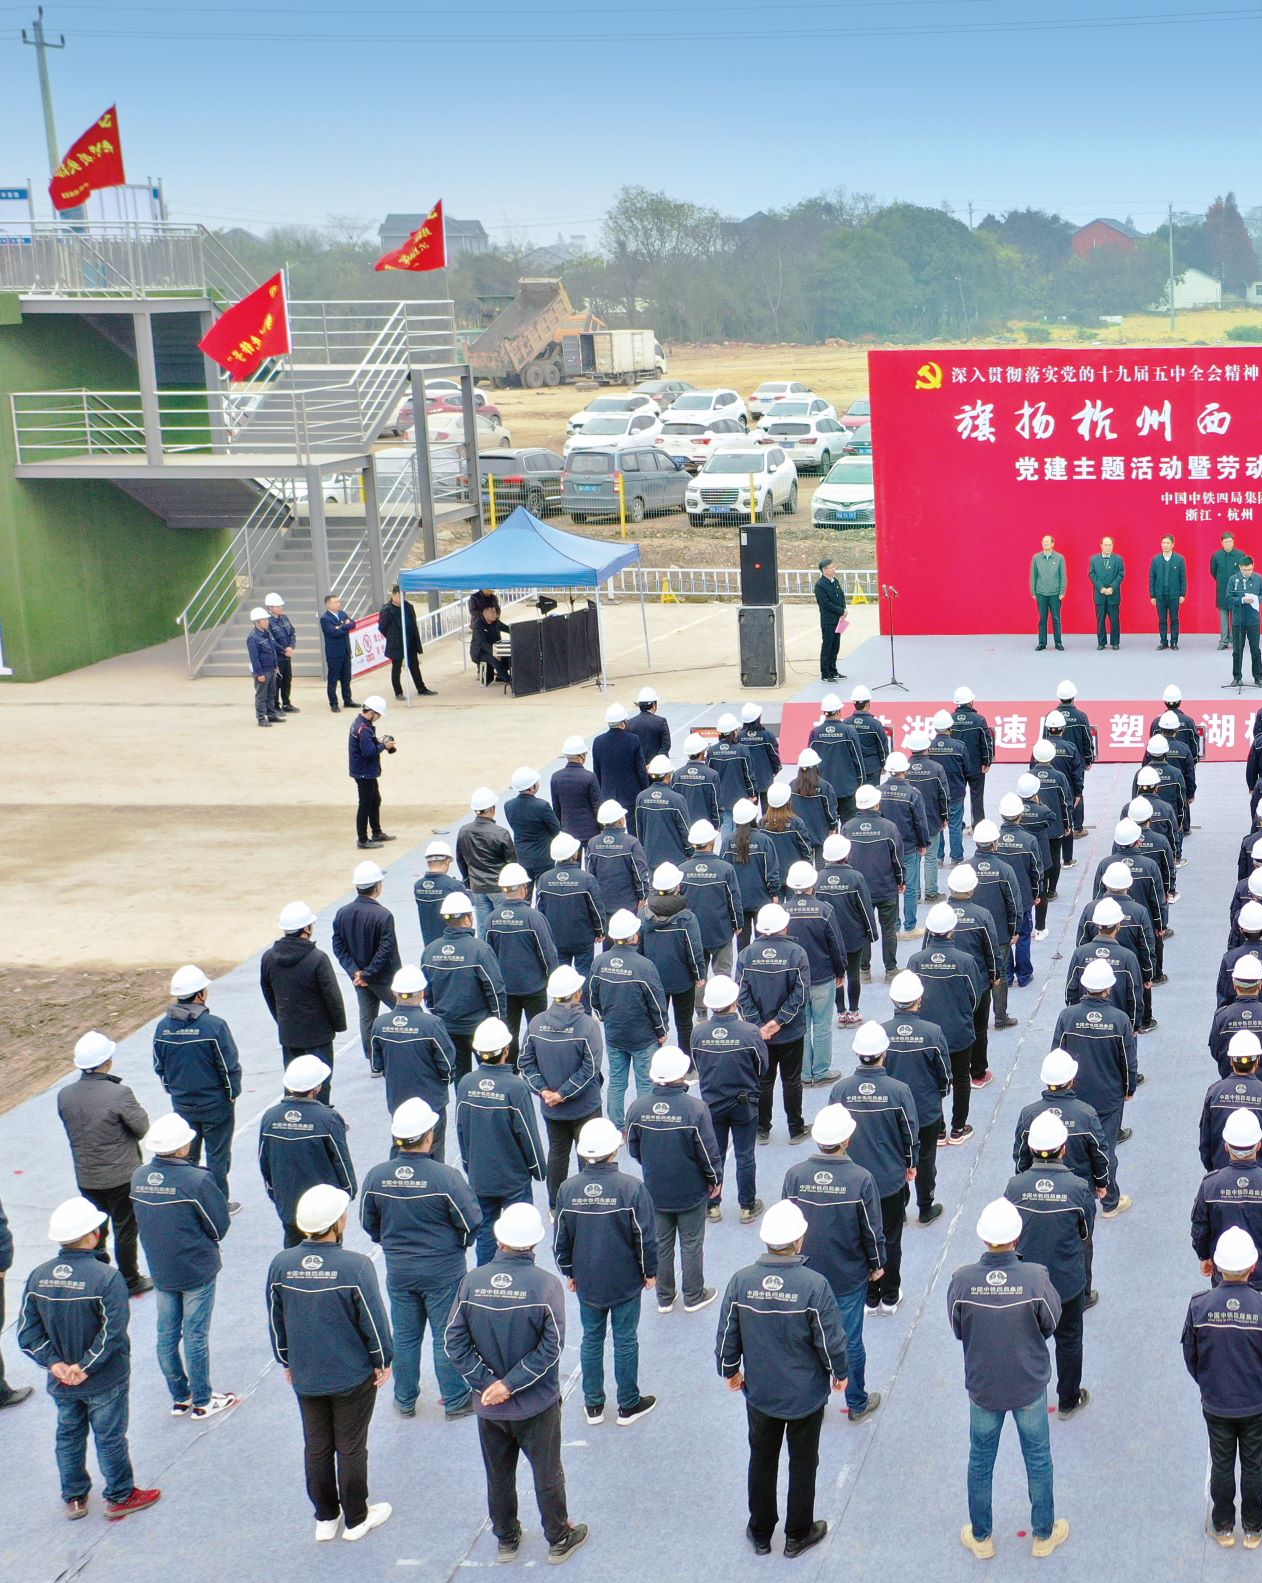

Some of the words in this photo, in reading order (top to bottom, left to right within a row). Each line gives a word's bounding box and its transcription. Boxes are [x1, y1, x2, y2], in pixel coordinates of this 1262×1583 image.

[951, 364, 1260, 384] 深入贯彻落实党的十九届五中全会精神
[954, 399, 1232, 443] 旗扬杭州西
